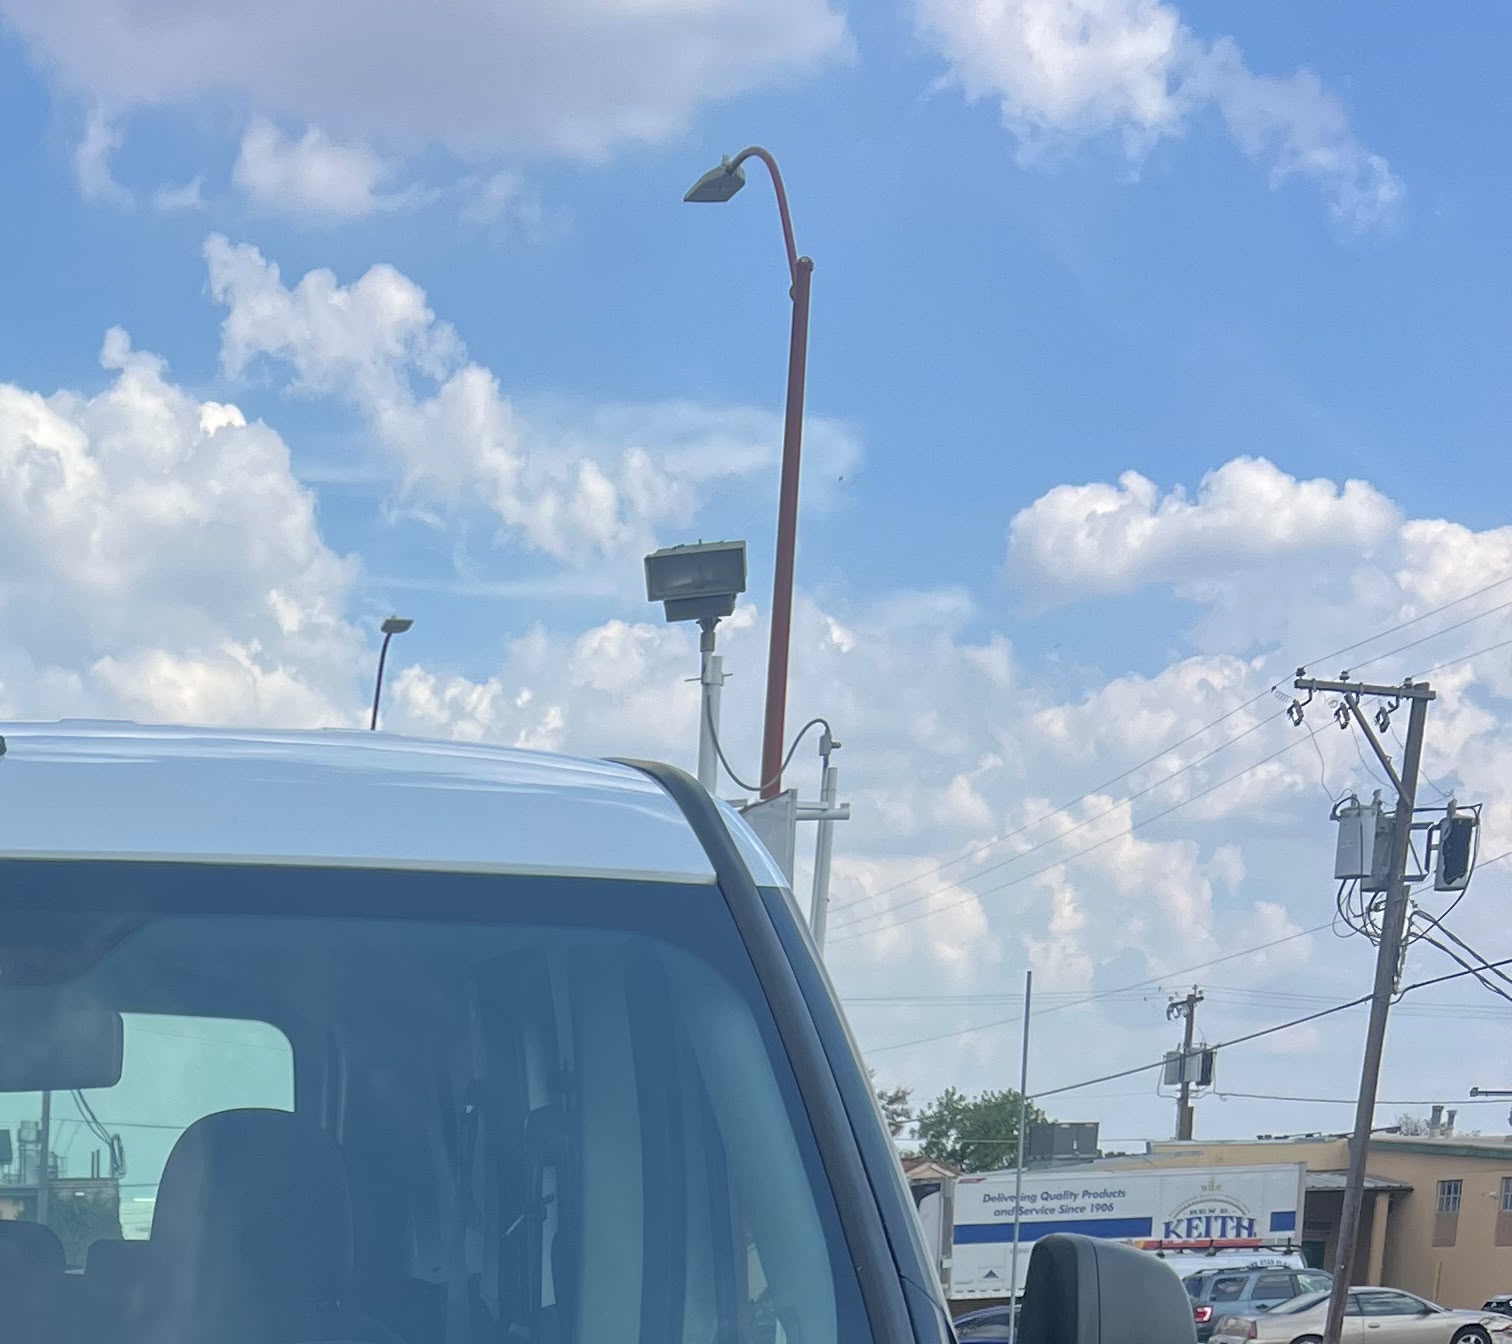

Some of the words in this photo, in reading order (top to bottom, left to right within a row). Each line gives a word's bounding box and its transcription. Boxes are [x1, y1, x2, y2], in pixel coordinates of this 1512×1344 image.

[983, 1192, 1037, 1204] Deliveing
[1040, 1190, 1079, 1203] Quality
[1082, 1188, 1126, 1200] Products
[993, 1206, 1018, 1217] and
[1018, 1205, 1056, 1216] Service
[1058, 1204, 1086, 1215] Since
[1090, 1202, 1114, 1213] 1906
